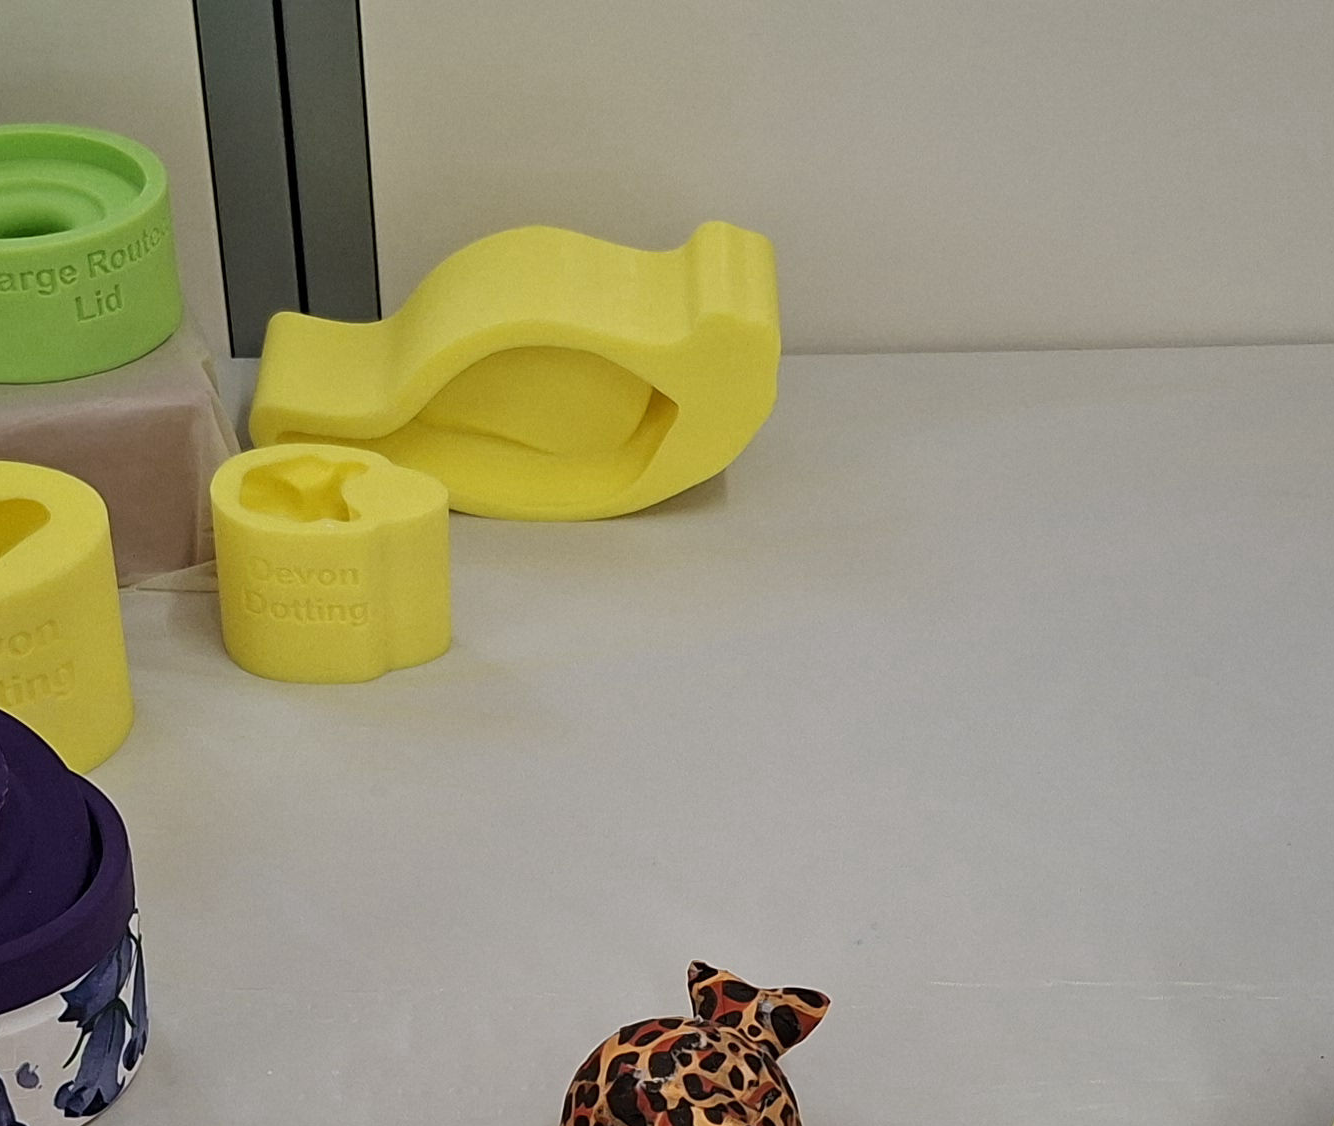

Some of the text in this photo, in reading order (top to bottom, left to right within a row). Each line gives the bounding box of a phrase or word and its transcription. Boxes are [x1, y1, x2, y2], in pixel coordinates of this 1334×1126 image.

[74, 283, 123, 322] Lid
[243, 555, 361, 587] Devon
[243, 586, 370, 627] Dotting
